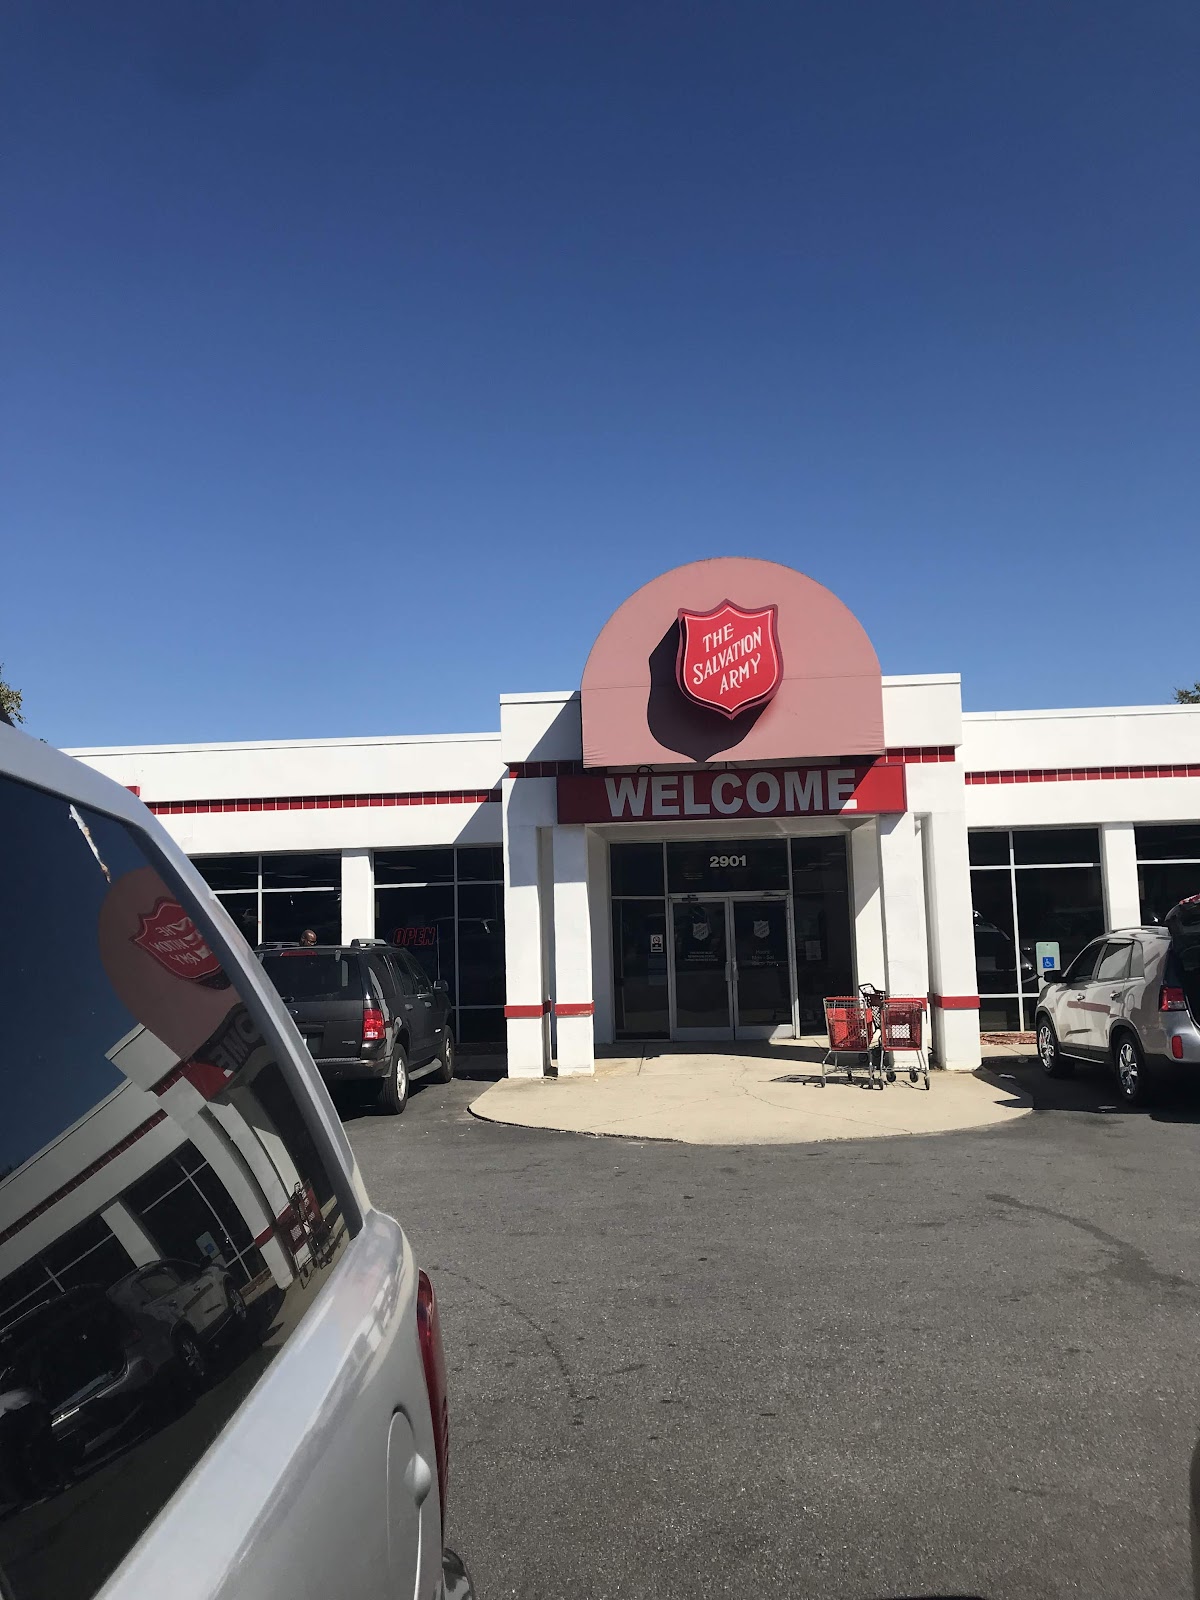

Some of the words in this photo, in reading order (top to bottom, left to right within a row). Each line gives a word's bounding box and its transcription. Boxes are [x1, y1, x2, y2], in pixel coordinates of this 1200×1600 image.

[692, 625, 762, 685] SALVATION
[702, 622, 735, 653] THE
[719, 652, 761, 696] ARMY
[604, 768, 858, 817] WELCOME
[709, 854, 747, 868] 2901
[393, 926, 436, 946] OPEN
